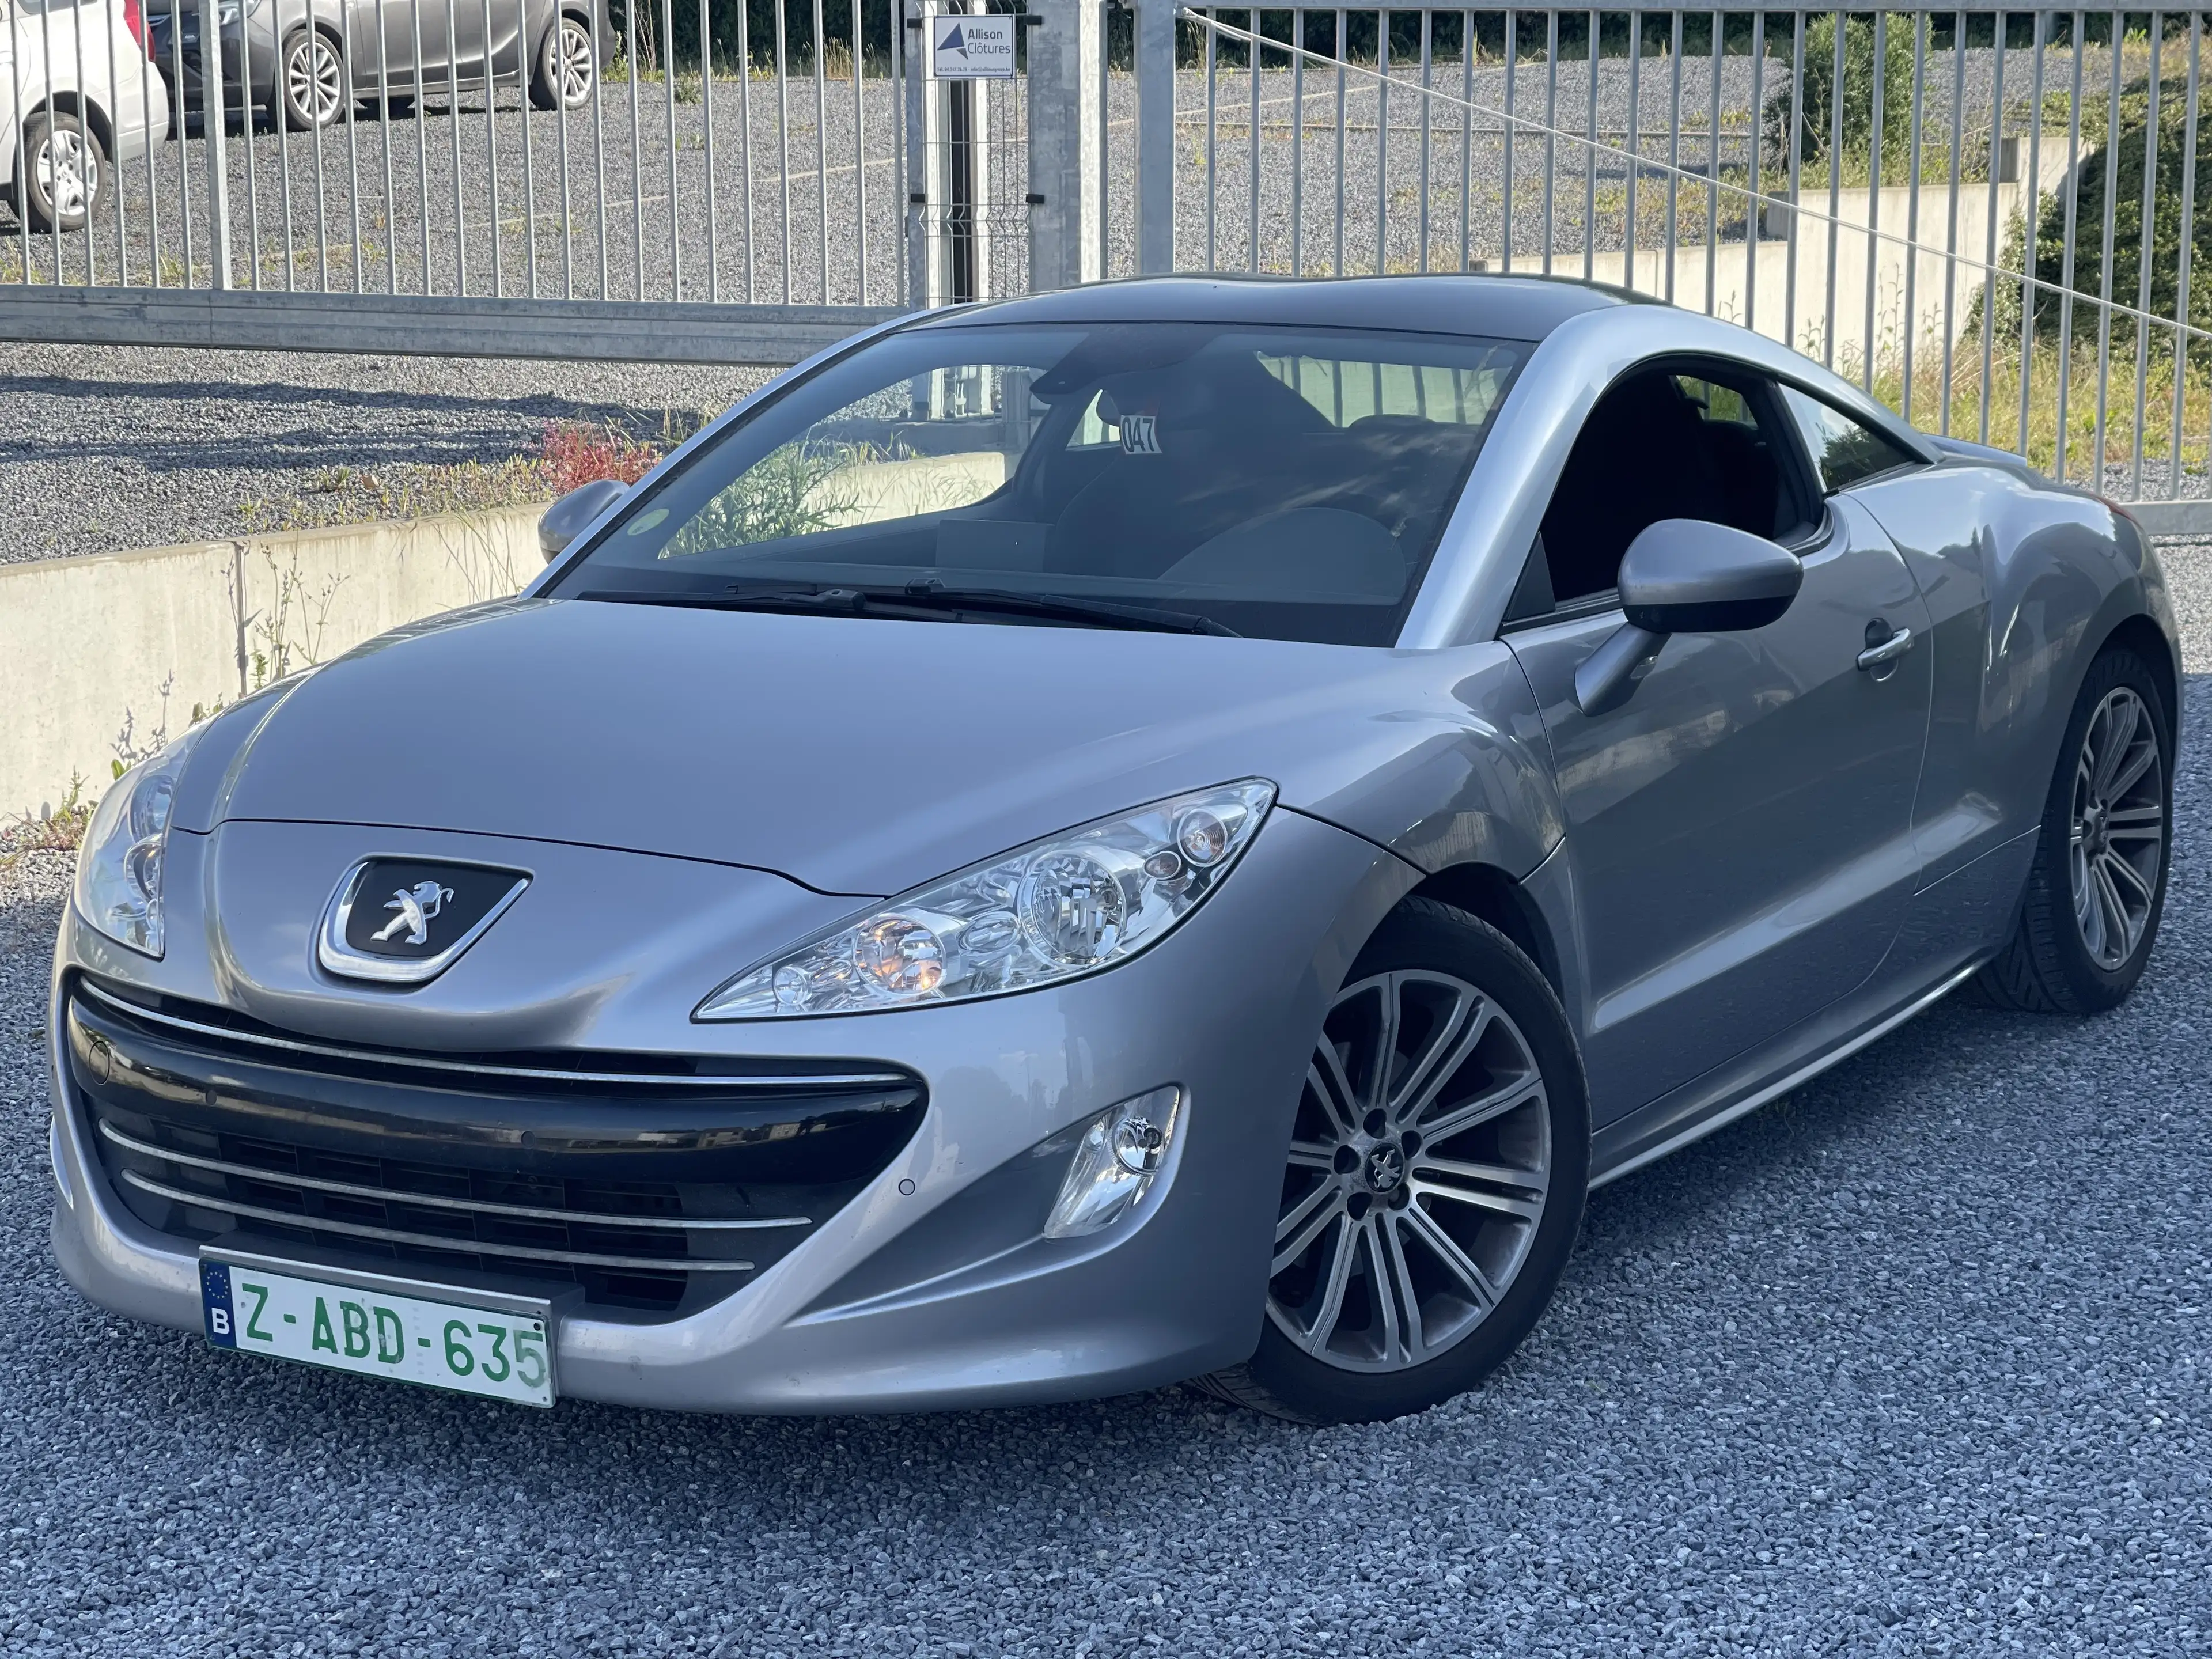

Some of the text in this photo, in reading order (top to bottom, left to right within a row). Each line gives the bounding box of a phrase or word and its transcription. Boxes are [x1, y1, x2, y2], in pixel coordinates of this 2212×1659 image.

[968, 28, 1003, 40] Allison
[968, 42, 1011, 54] Clôtures
[1122, 416, 1154, 452] 047
[211, 1308, 230, 1335] B
[242, 1282, 546, 1388] Z-ABD-635
